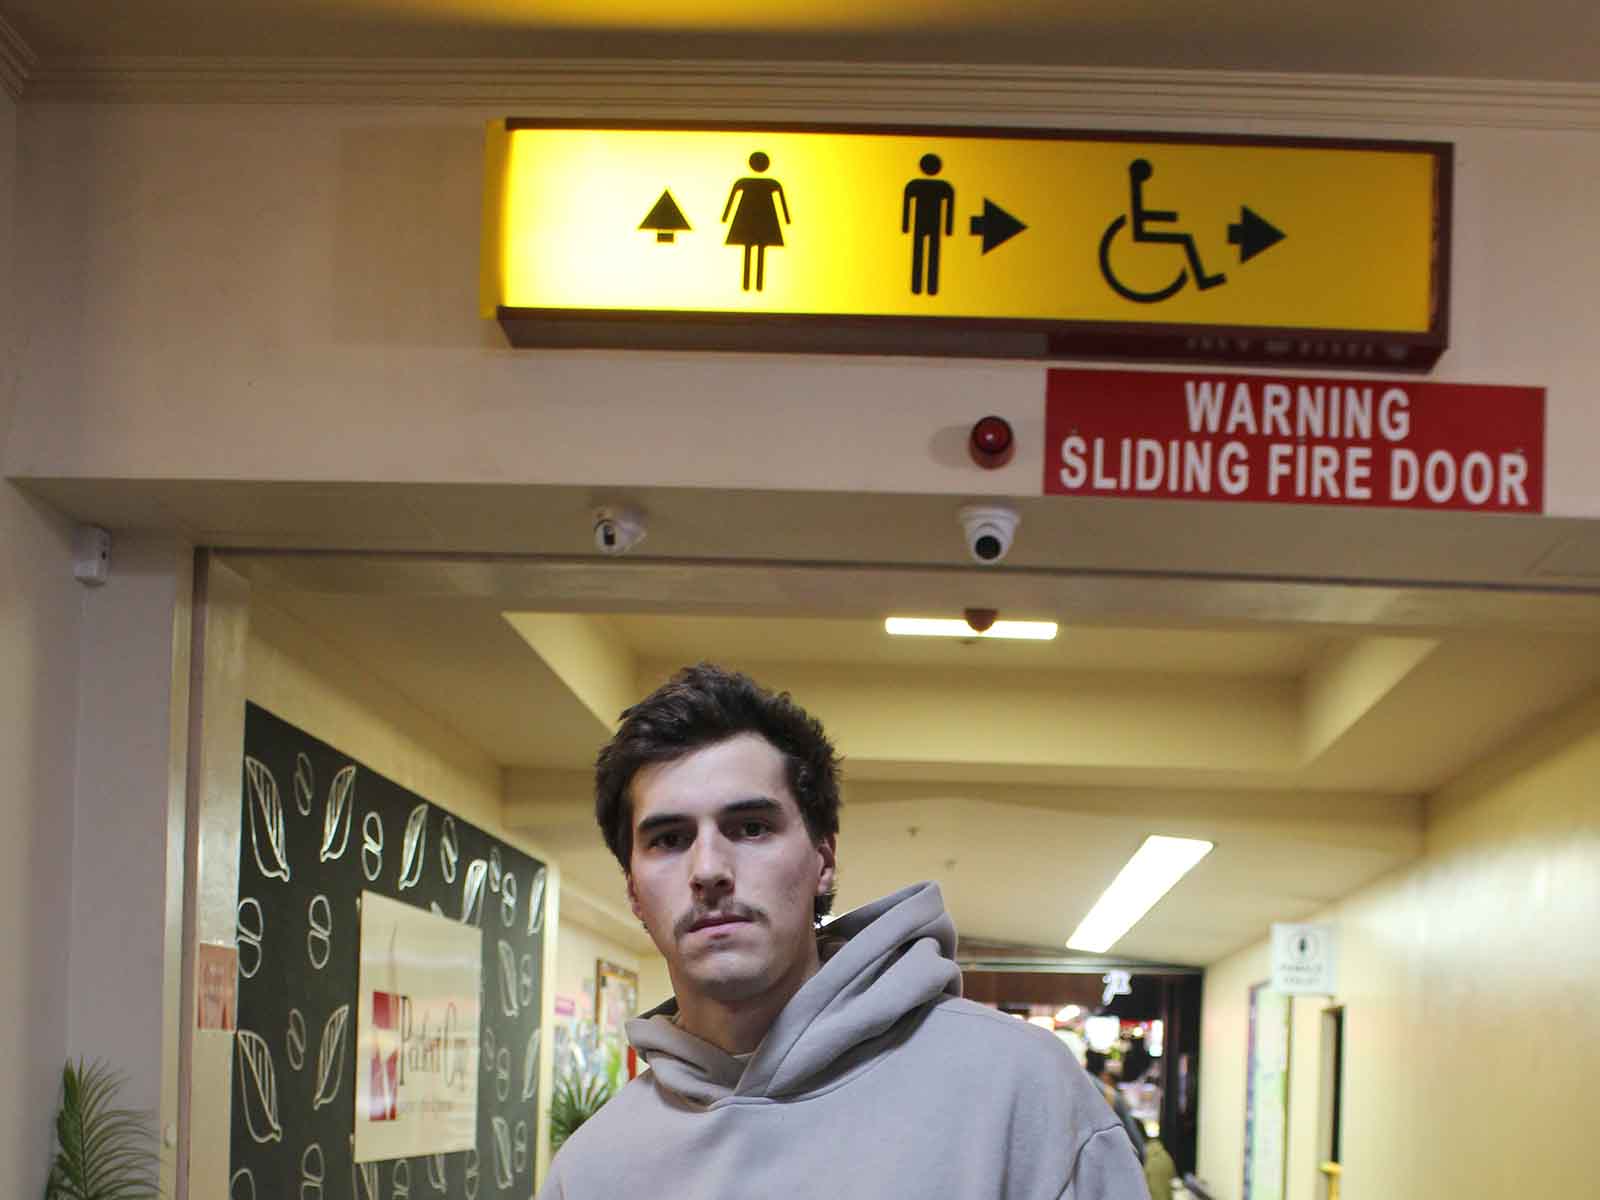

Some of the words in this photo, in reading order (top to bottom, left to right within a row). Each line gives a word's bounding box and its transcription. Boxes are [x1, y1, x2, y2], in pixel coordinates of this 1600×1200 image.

[1184, 380, 1411, 441] WARNING
[1059, 435, 1250, 494] SLIDING
[1267, 443, 1373, 499] FIRE
[1390, 449, 1529, 506] DOOR
